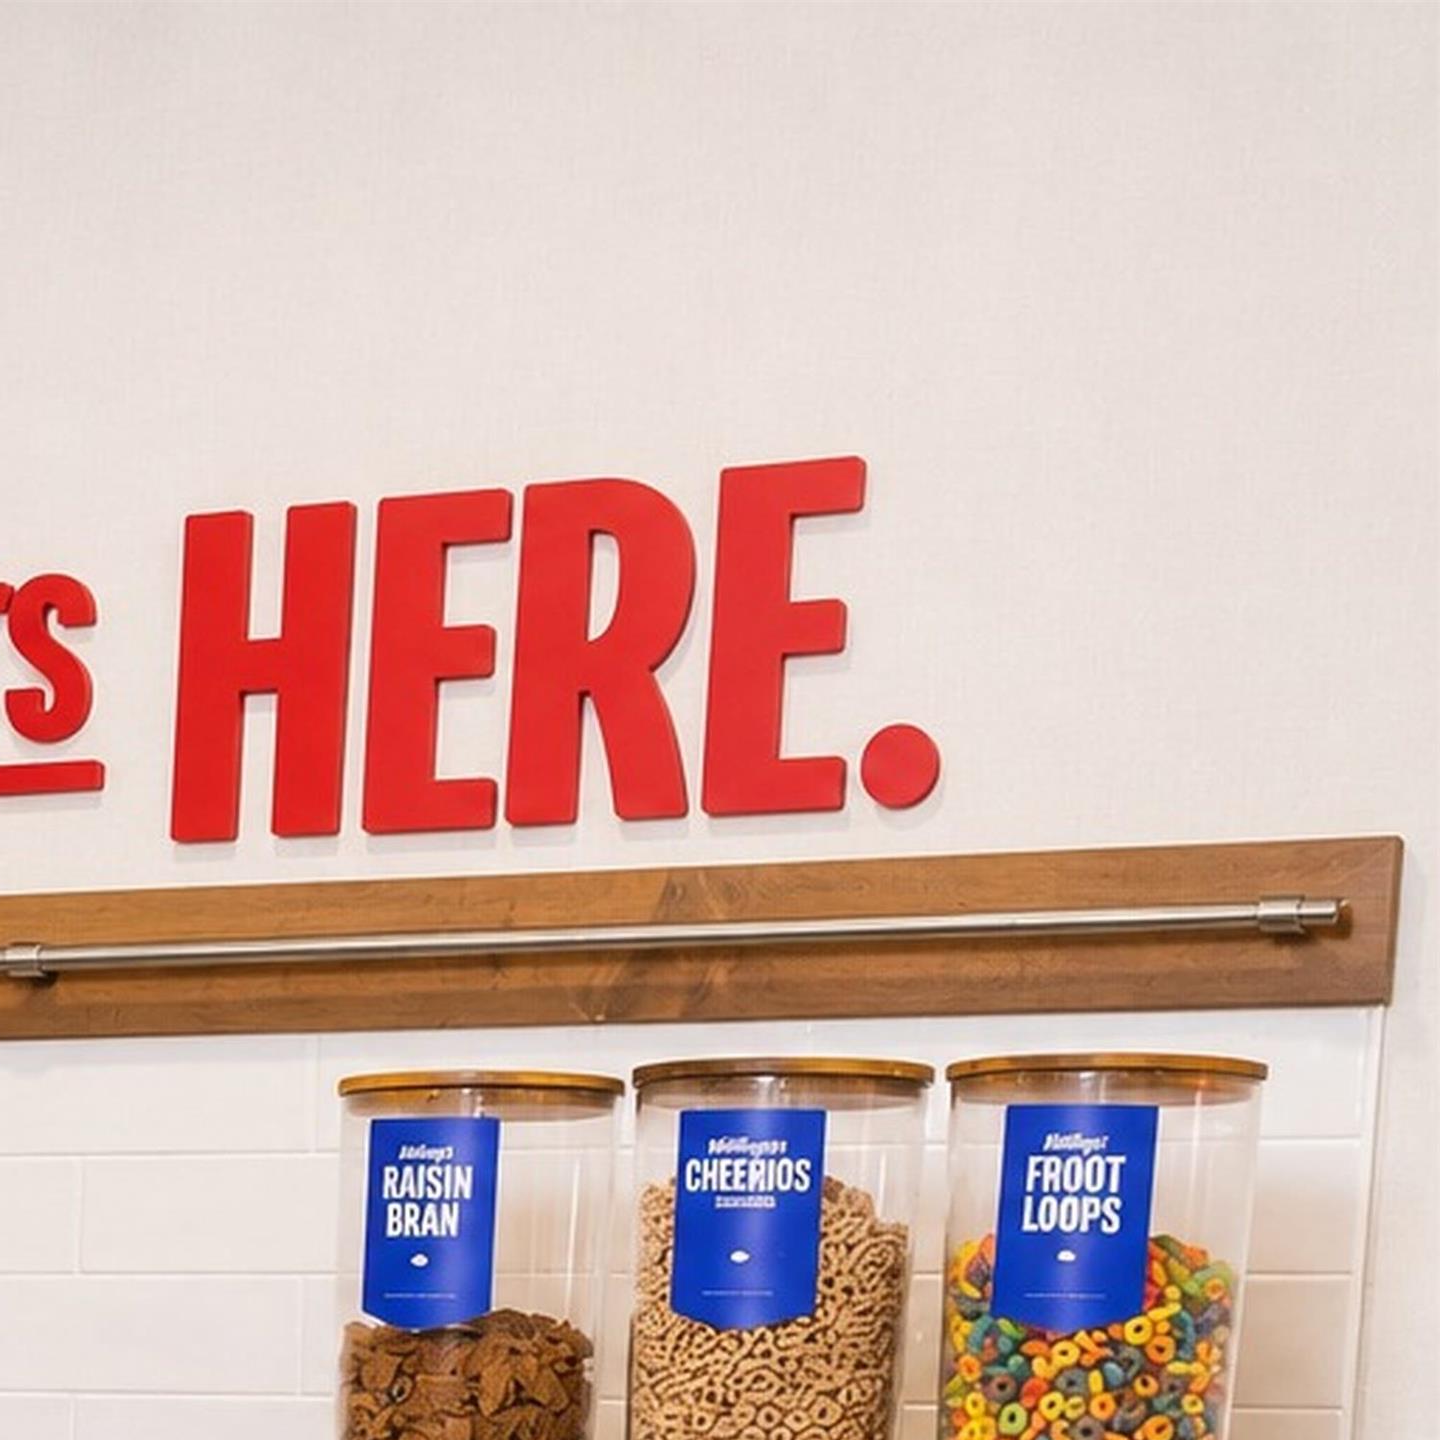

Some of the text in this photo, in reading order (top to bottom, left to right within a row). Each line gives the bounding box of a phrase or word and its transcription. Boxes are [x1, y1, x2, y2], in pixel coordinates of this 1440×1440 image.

[169, 456, 941, 844] HERE.
[382, 1164, 473, 1200] RAISIN
[685, 1157, 812, 1193] CHEERIOS
[1025, 1155, 1127, 1194] FROOT
[386, 1201, 460, 1238] BRAN
[1021, 1194, 1122, 1235] LOOPS
